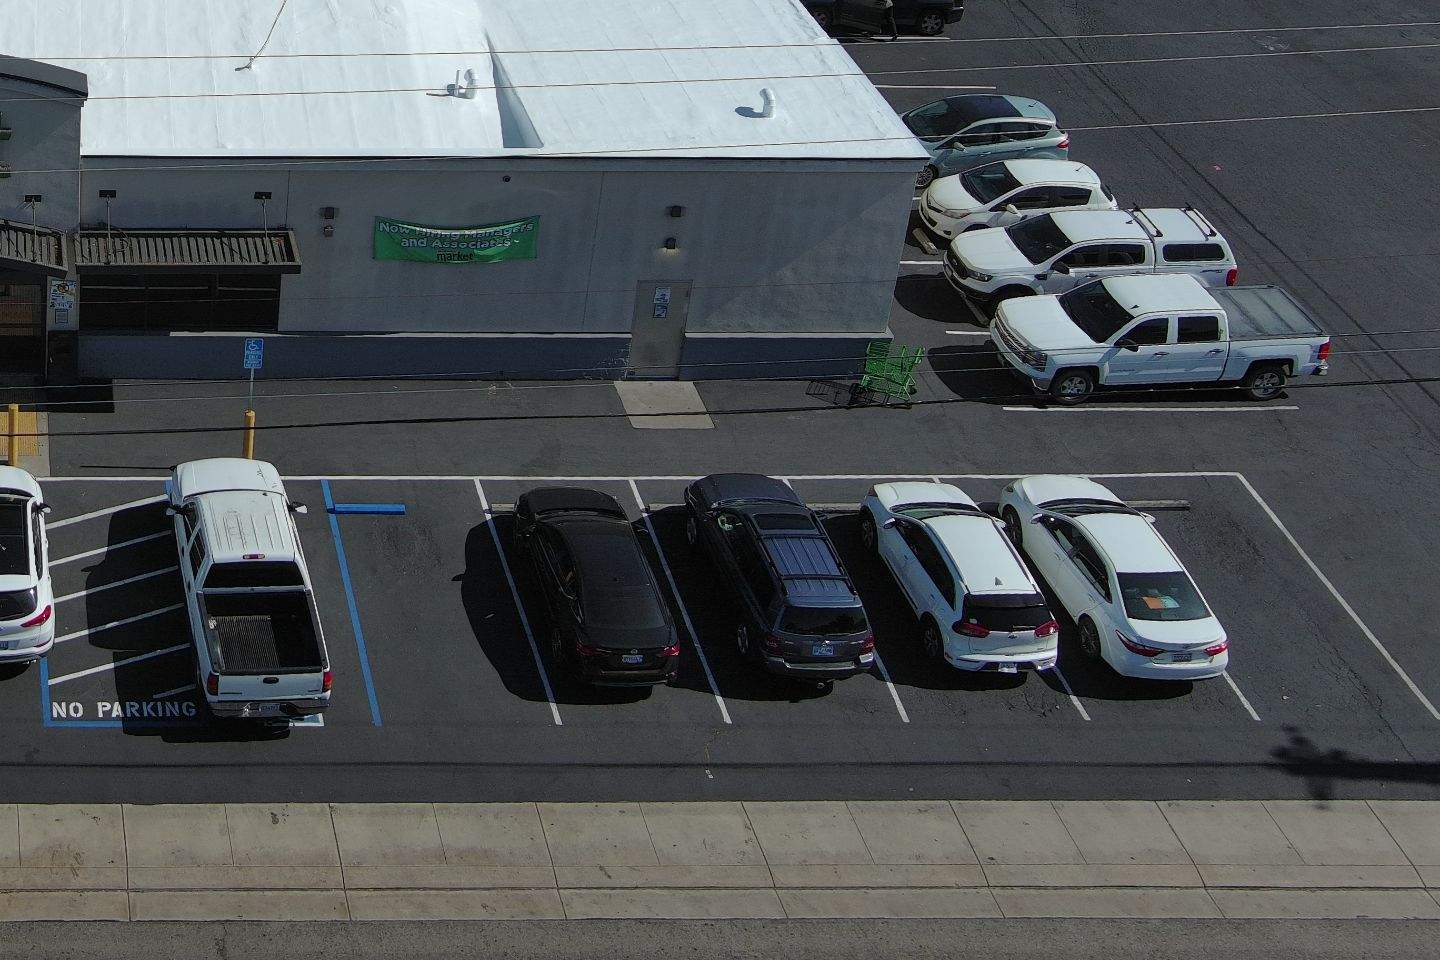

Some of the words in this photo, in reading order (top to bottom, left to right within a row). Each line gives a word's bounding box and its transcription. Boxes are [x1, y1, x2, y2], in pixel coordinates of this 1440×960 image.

[378, 222, 411, 234] Now
[401, 237, 427, 248] and
[432, 238, 512, 248] Associates
[436, 250, 475, 261] market
[52, 701, 83, 718] NO
[97, 701, 197, 719] PARKING
